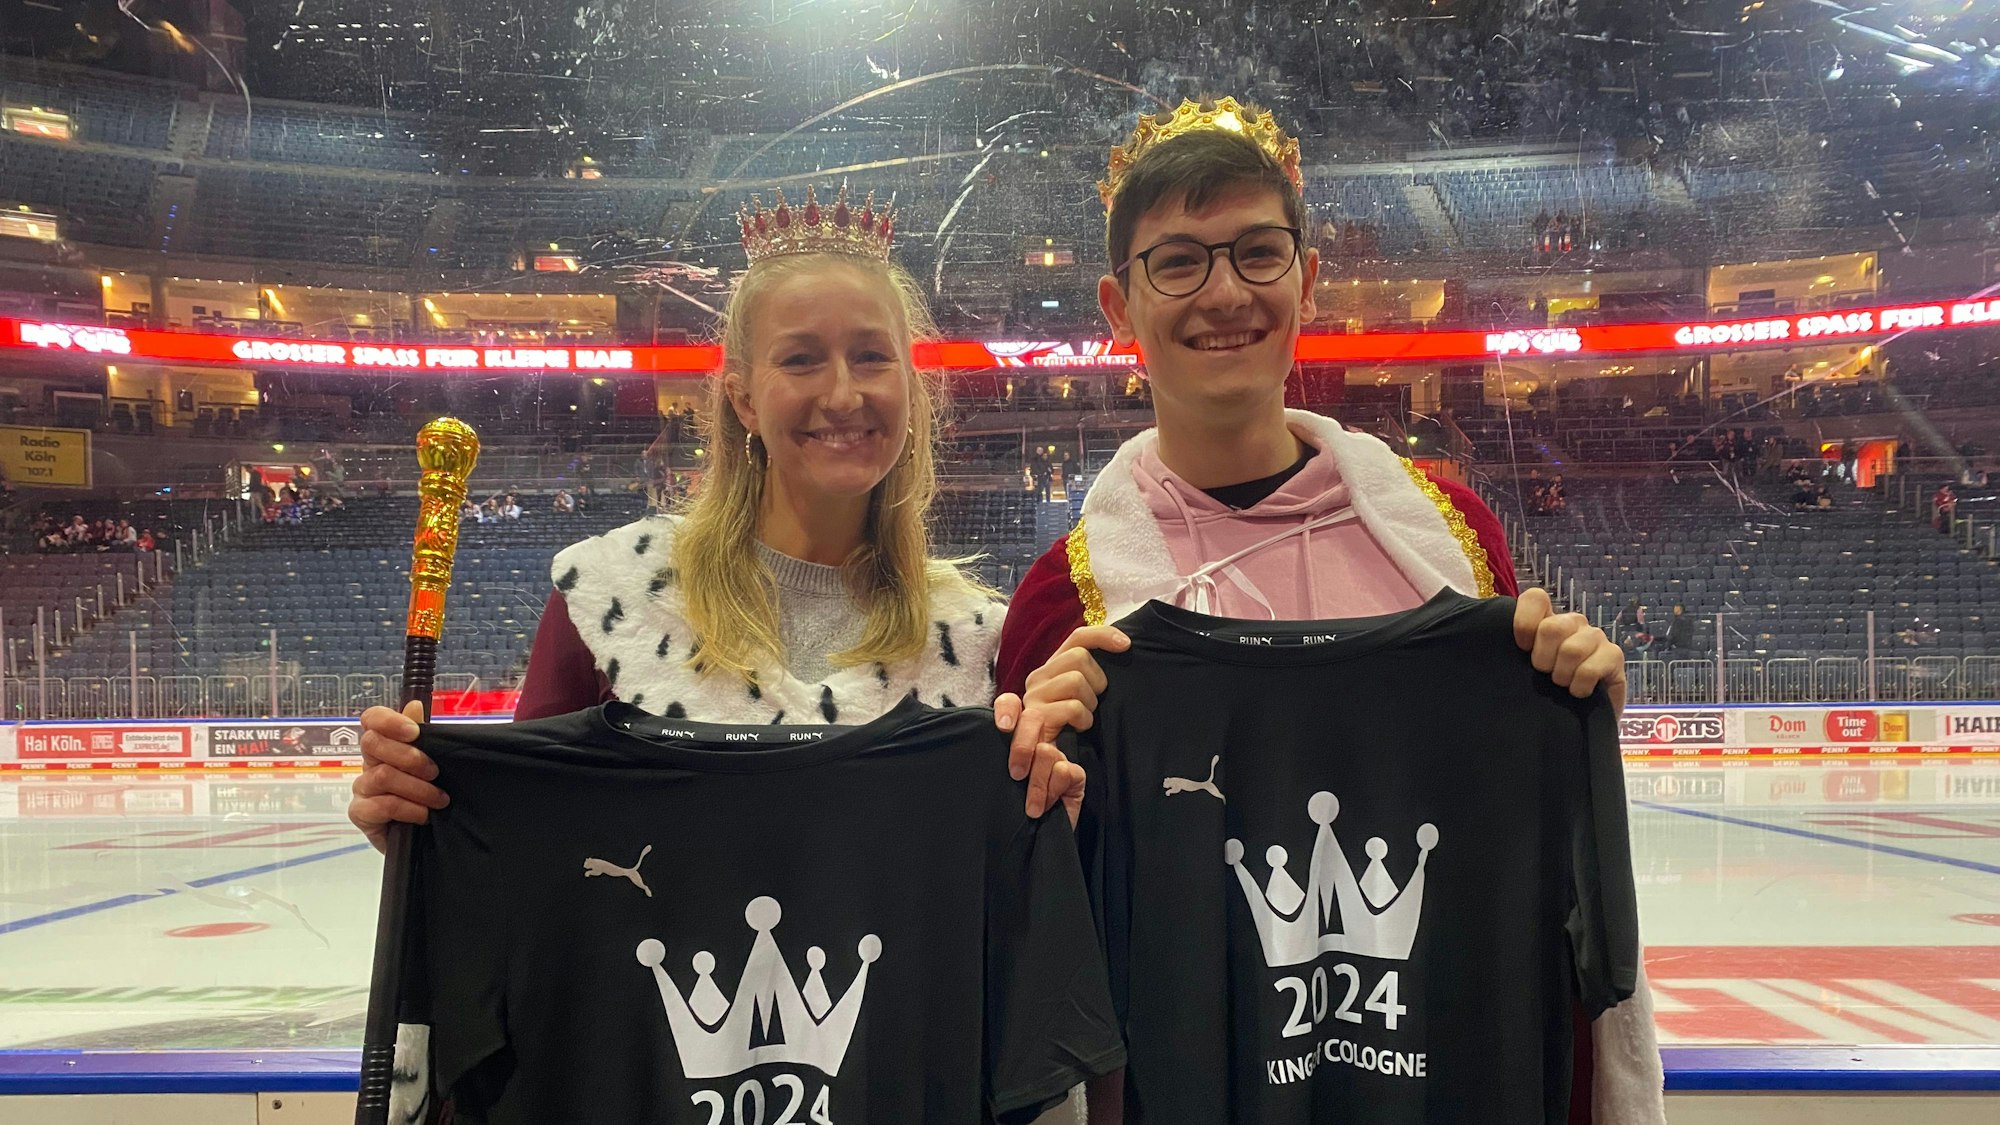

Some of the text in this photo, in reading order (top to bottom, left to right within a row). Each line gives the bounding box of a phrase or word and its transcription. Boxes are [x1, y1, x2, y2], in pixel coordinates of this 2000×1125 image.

[1675, 319, 1791, 345] GROSSER
[1797, 311, 1874, 337] SPASS
[232, 340, 346, 364] GROSSER
[20, 435, 60, 448] Radio
[24, 450, 57, 463] Köln
[27, 467, 53, 478] 107.1
[1768, 714, 1807, 733] Dom
[1836, 716, 1867, 728] Time
[214, 729, 281, 741] STARK WIE
[661, 728, 684, 738] RUN
[725, 733, 748, 741] RUN
[789, 732, 812, 740] RUN
[1842, 727, 1865, 738] out
[24, 735, 48, 752] Hai
[51, 734, 87, 752] Köln.
[214, 744, 236, 755] EIN
[1273, 963, 1407, 1038] 2024
[1267, 1051, 1313, 1084] KING
[1324, 1038, 1427, 1078] COLOGNE
[690, 1073, 834, 1125] 2024
